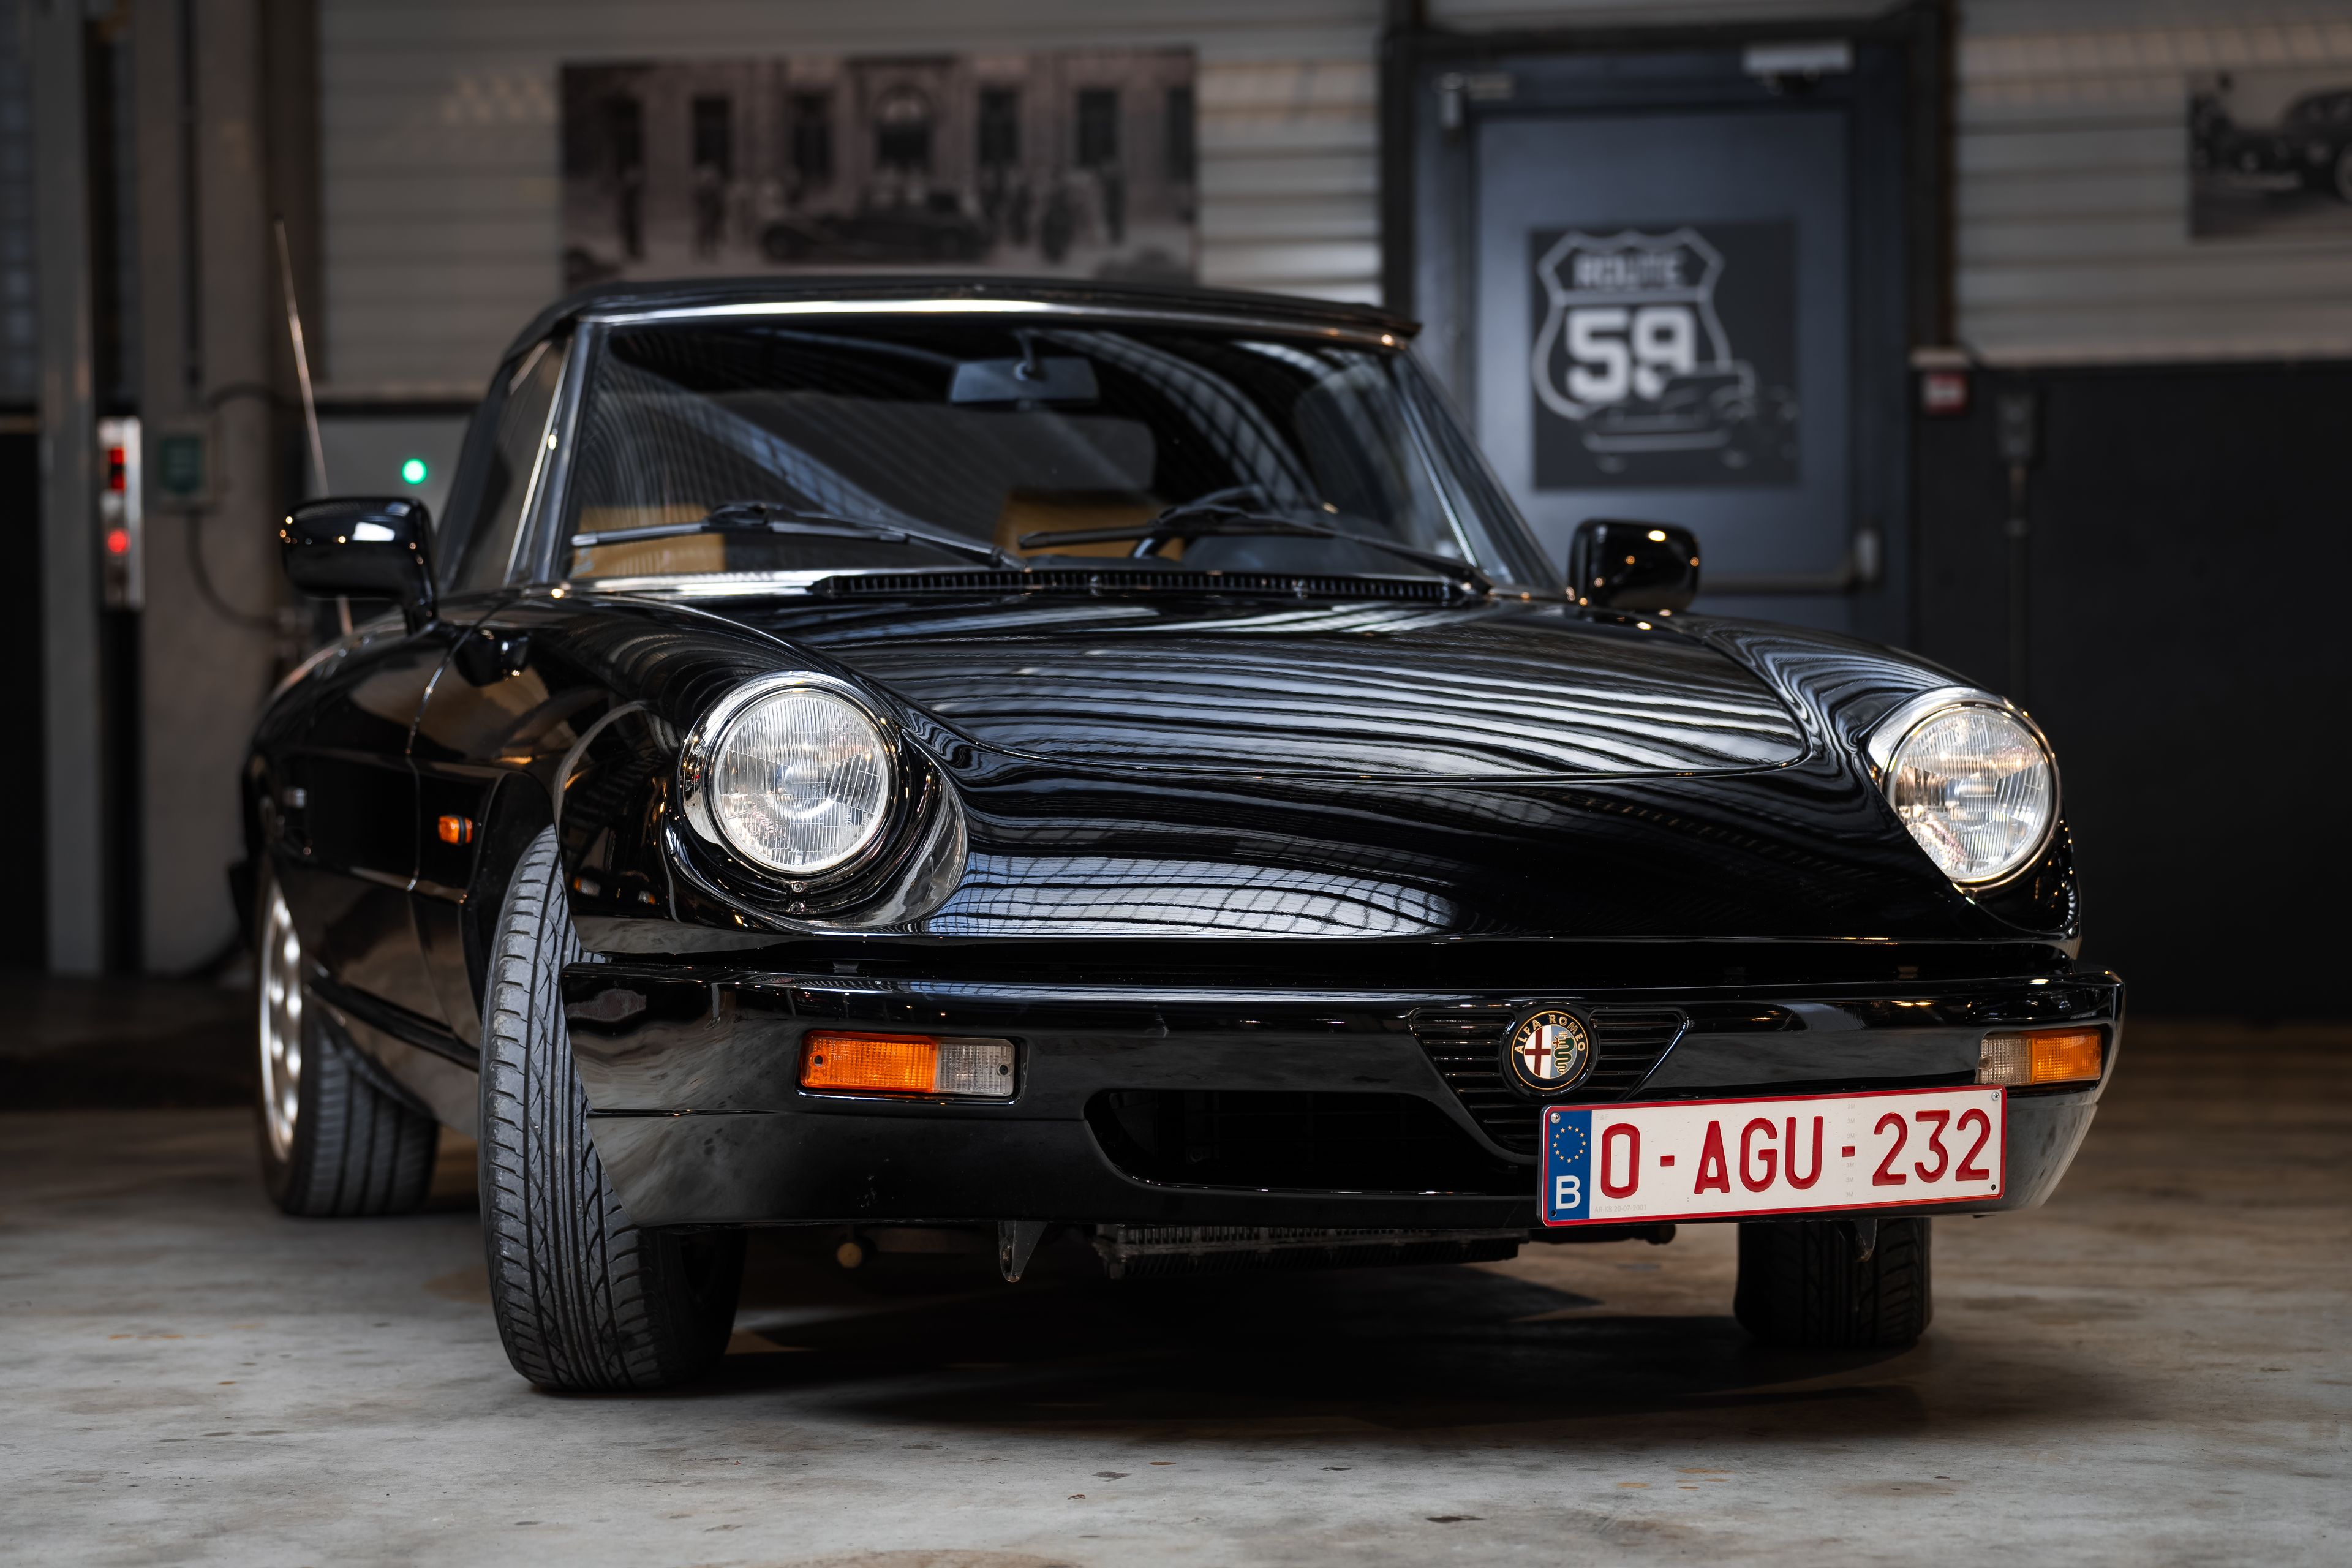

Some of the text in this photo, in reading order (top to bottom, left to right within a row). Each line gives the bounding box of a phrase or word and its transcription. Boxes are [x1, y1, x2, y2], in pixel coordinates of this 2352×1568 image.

[1566, 306, 1697, 401] 59
[1515, 1014, 1586, 1055] ALFA ROMEO
[1556, 1175, 1581, 1209] B
[1614, 1204, 1647, 1212] 20-07-2001
